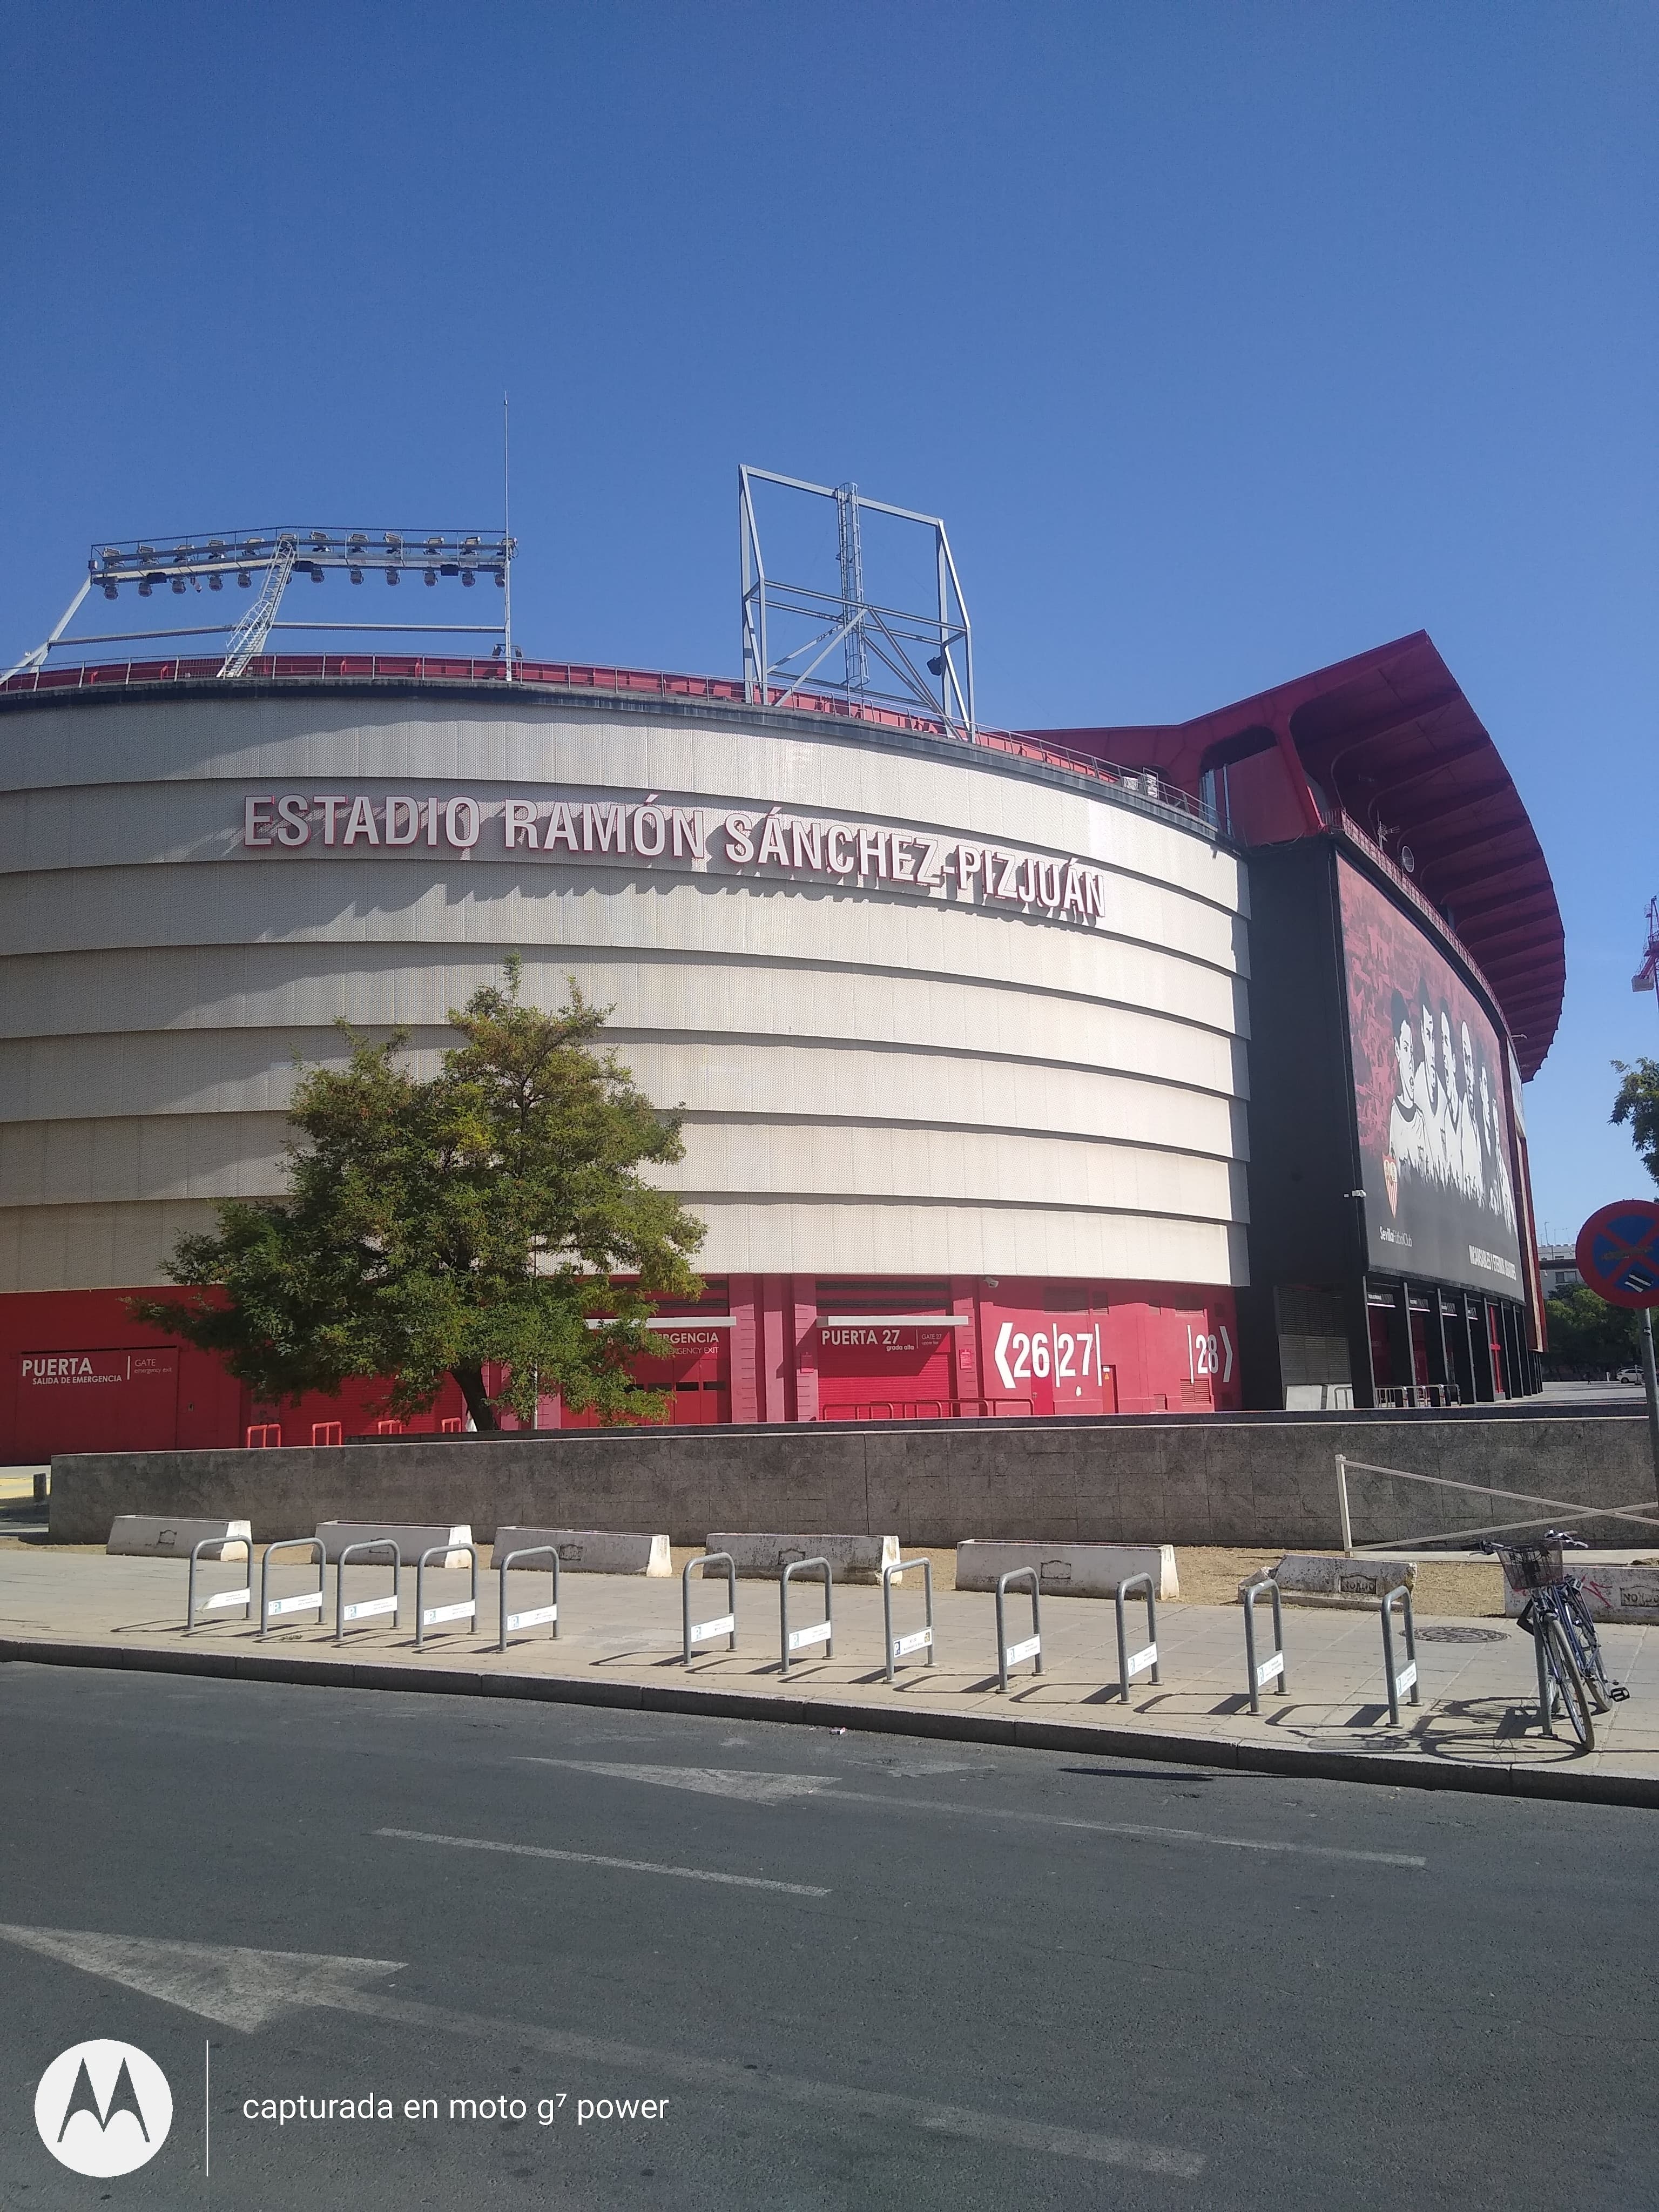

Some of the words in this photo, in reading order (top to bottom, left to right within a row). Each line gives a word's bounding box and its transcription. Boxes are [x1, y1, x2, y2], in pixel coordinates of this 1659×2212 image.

[245, 795, 480, 847] ESTADIO
[505, 794, 704, 858] RAMÓN
[822, 1330, 878, 1345] PUERTA
[882, 1330, 900, 1345] 27
[134, 1359, 156, 1367] GATE
[1013, 1333, 1050, 1378] 26
[1058, 1333, 1093, 1377] 27
[1195, 1334, 1219, 1374] 28
[22, 1357, 93, 1377] PUERTA
[32, 1377, 59, 1385] SALIDA
[72, 1375, 122, 1384] EMERGENCIA
